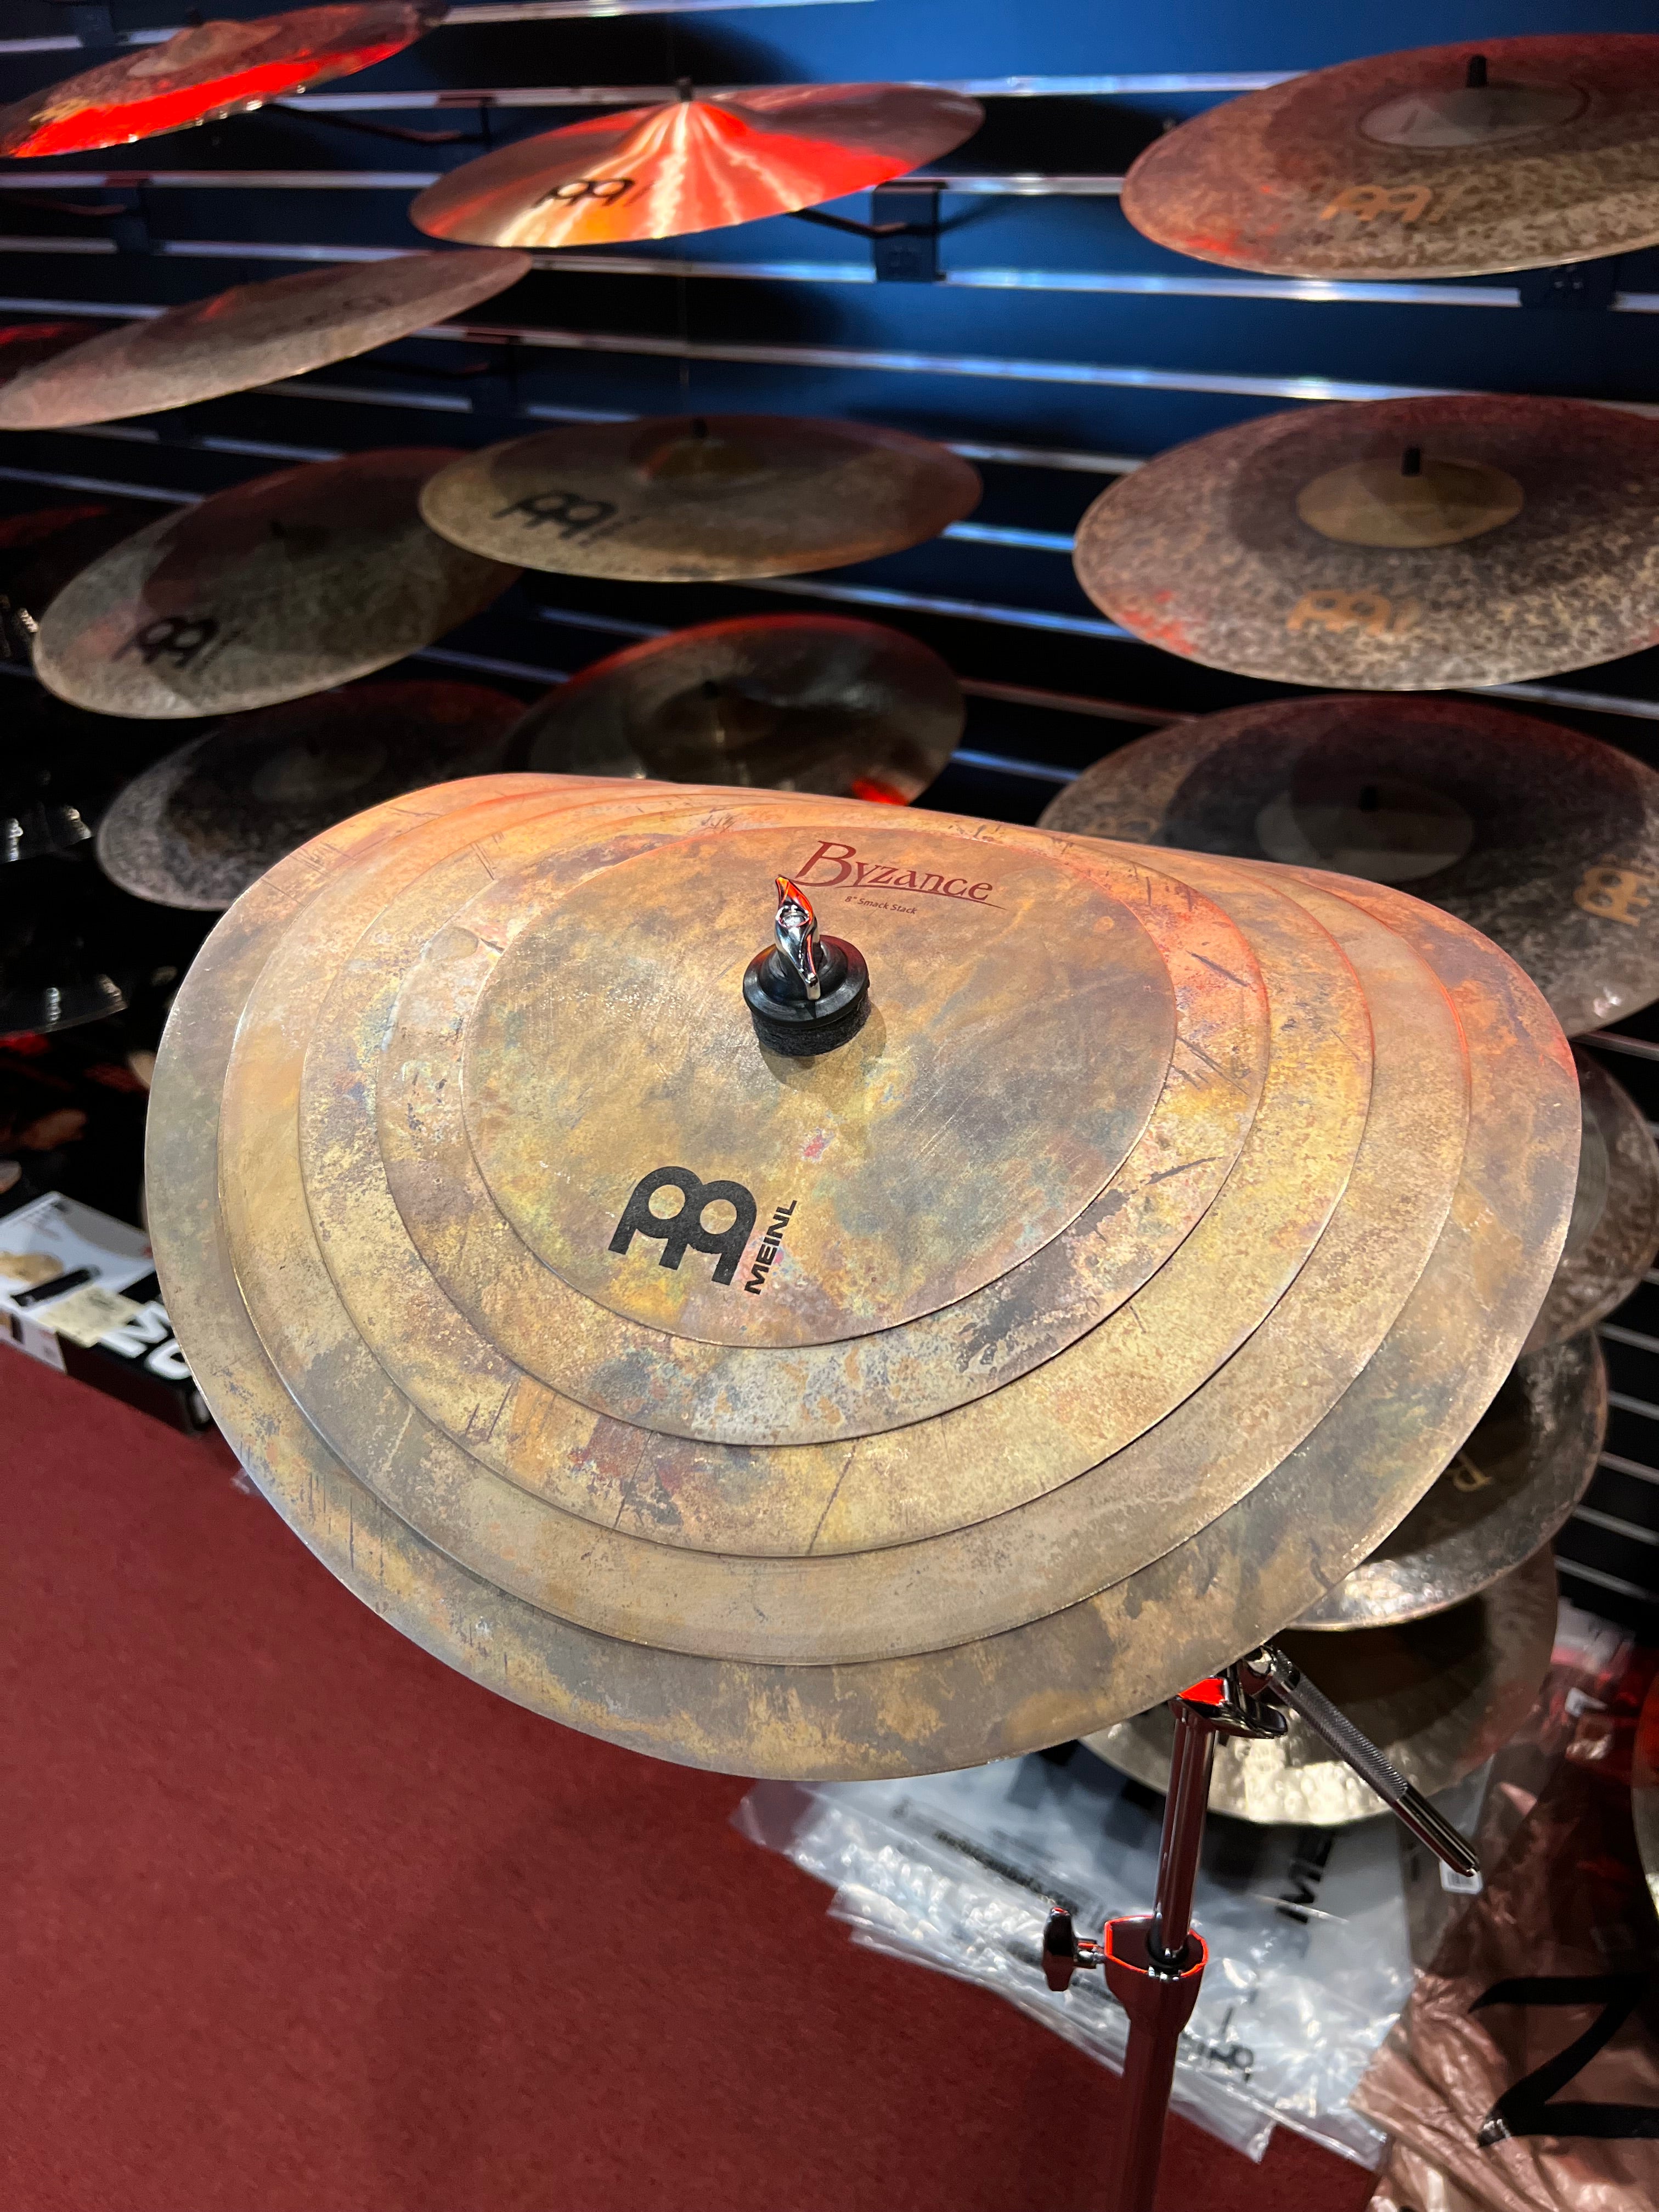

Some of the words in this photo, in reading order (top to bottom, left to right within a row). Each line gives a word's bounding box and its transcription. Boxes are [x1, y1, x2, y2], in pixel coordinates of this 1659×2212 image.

[790, 840, 994, 905] Byzance
[857, 898, 889, 910] Smack
[890, 904, 917, 915] Stack
[744, 1200, 798, 1295] MEINL
